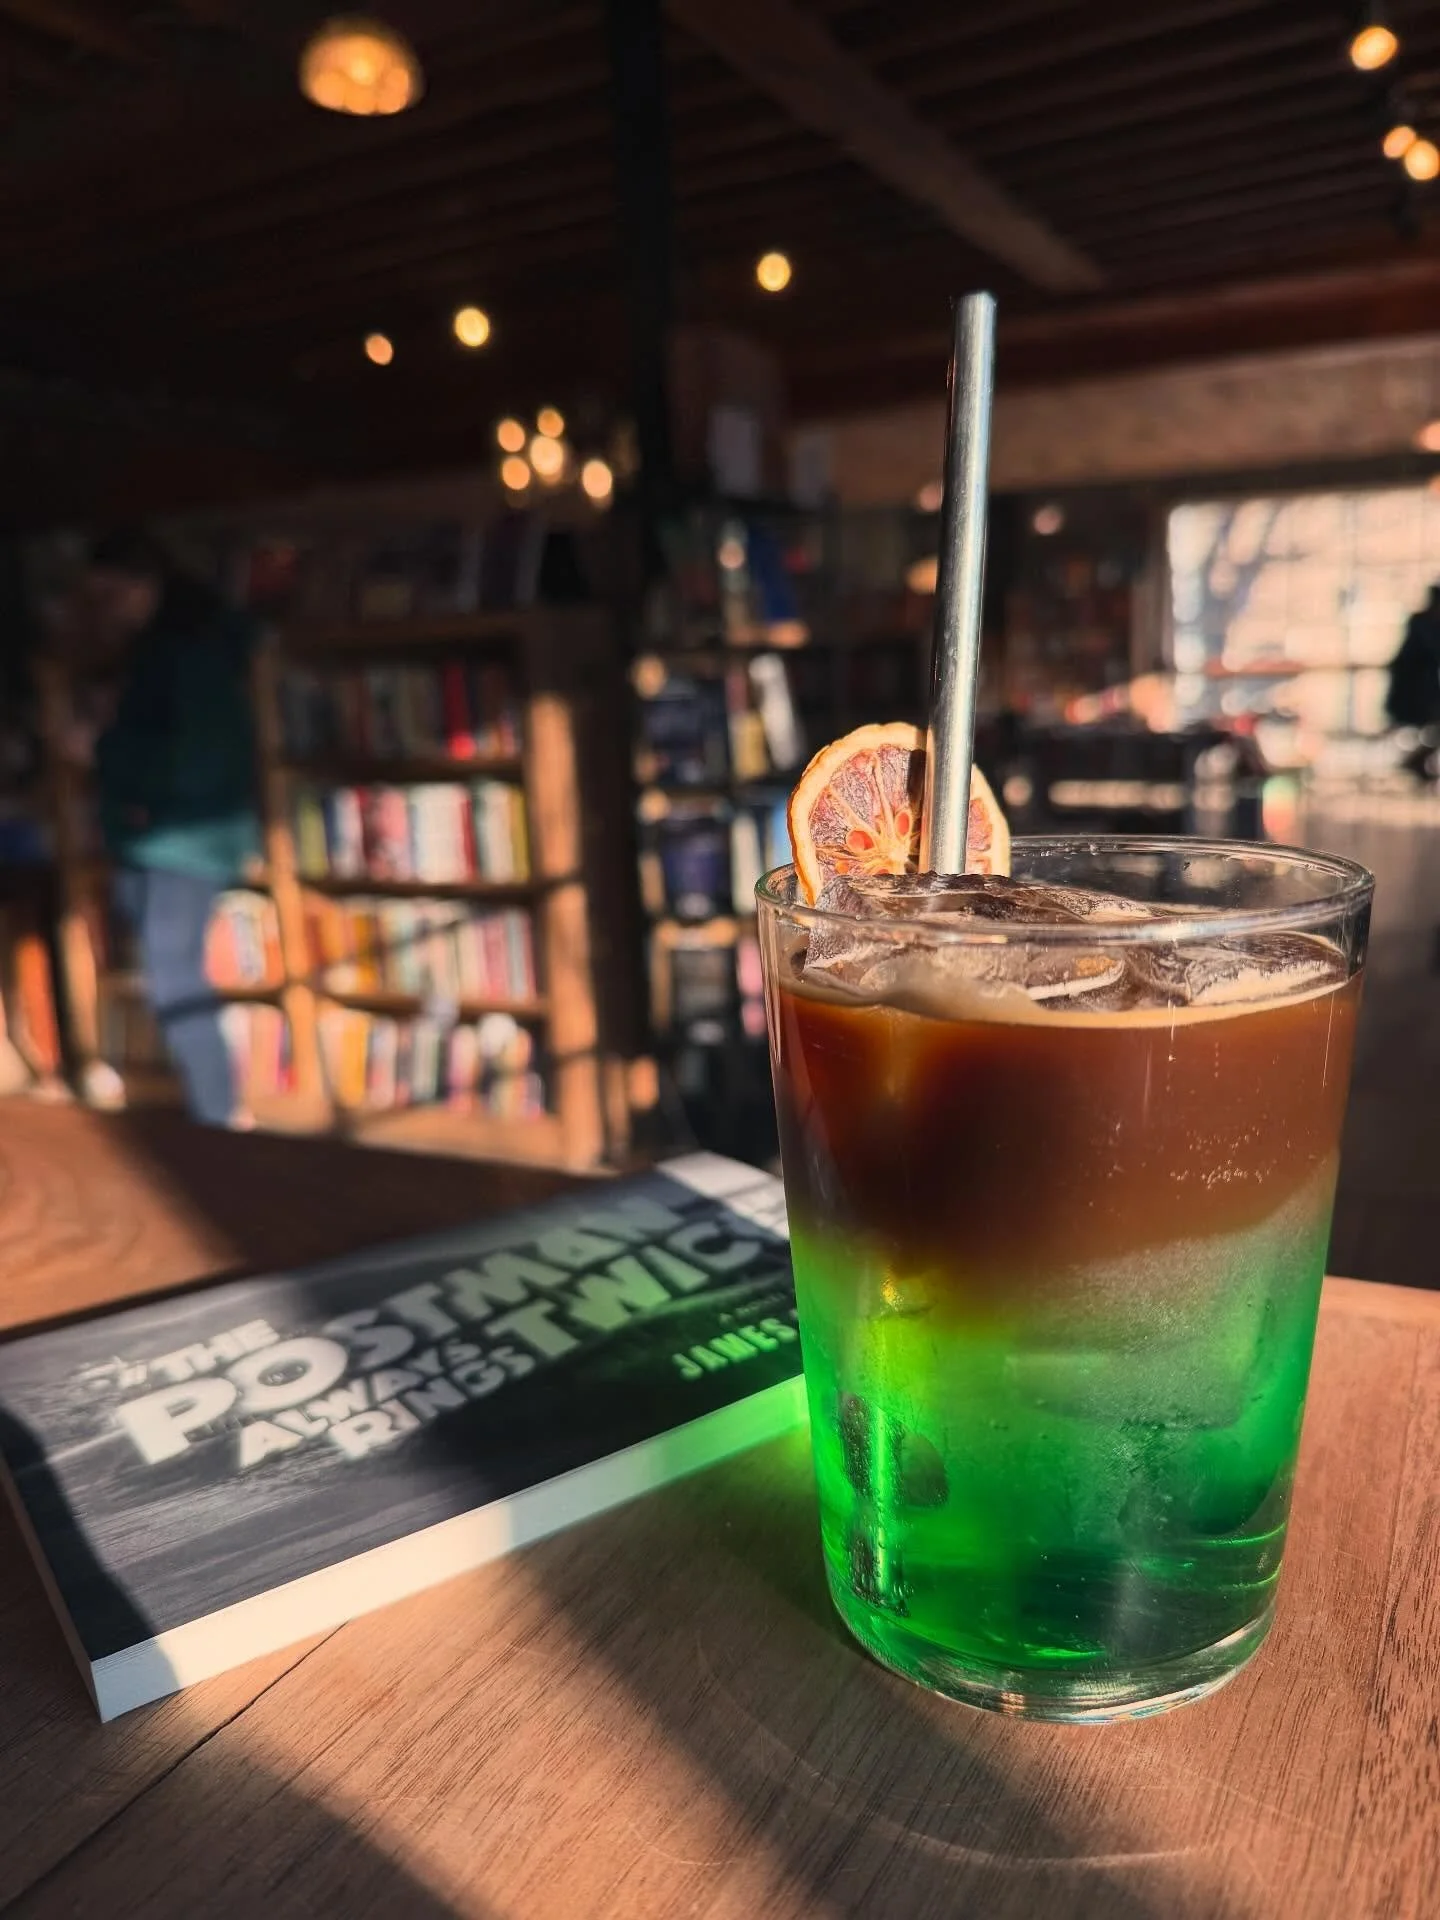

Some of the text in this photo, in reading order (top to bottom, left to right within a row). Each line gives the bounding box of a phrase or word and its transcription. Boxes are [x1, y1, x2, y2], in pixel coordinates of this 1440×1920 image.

[116, 1198, 685, 1465] POSTMAN
[151, 1318, 281, 1383] THE
[672, 1317, 798, 1381] JAMES
[239, 1337, 482, 1468] ALWAYS
[327, 1345, 535, 1459] RINGS
